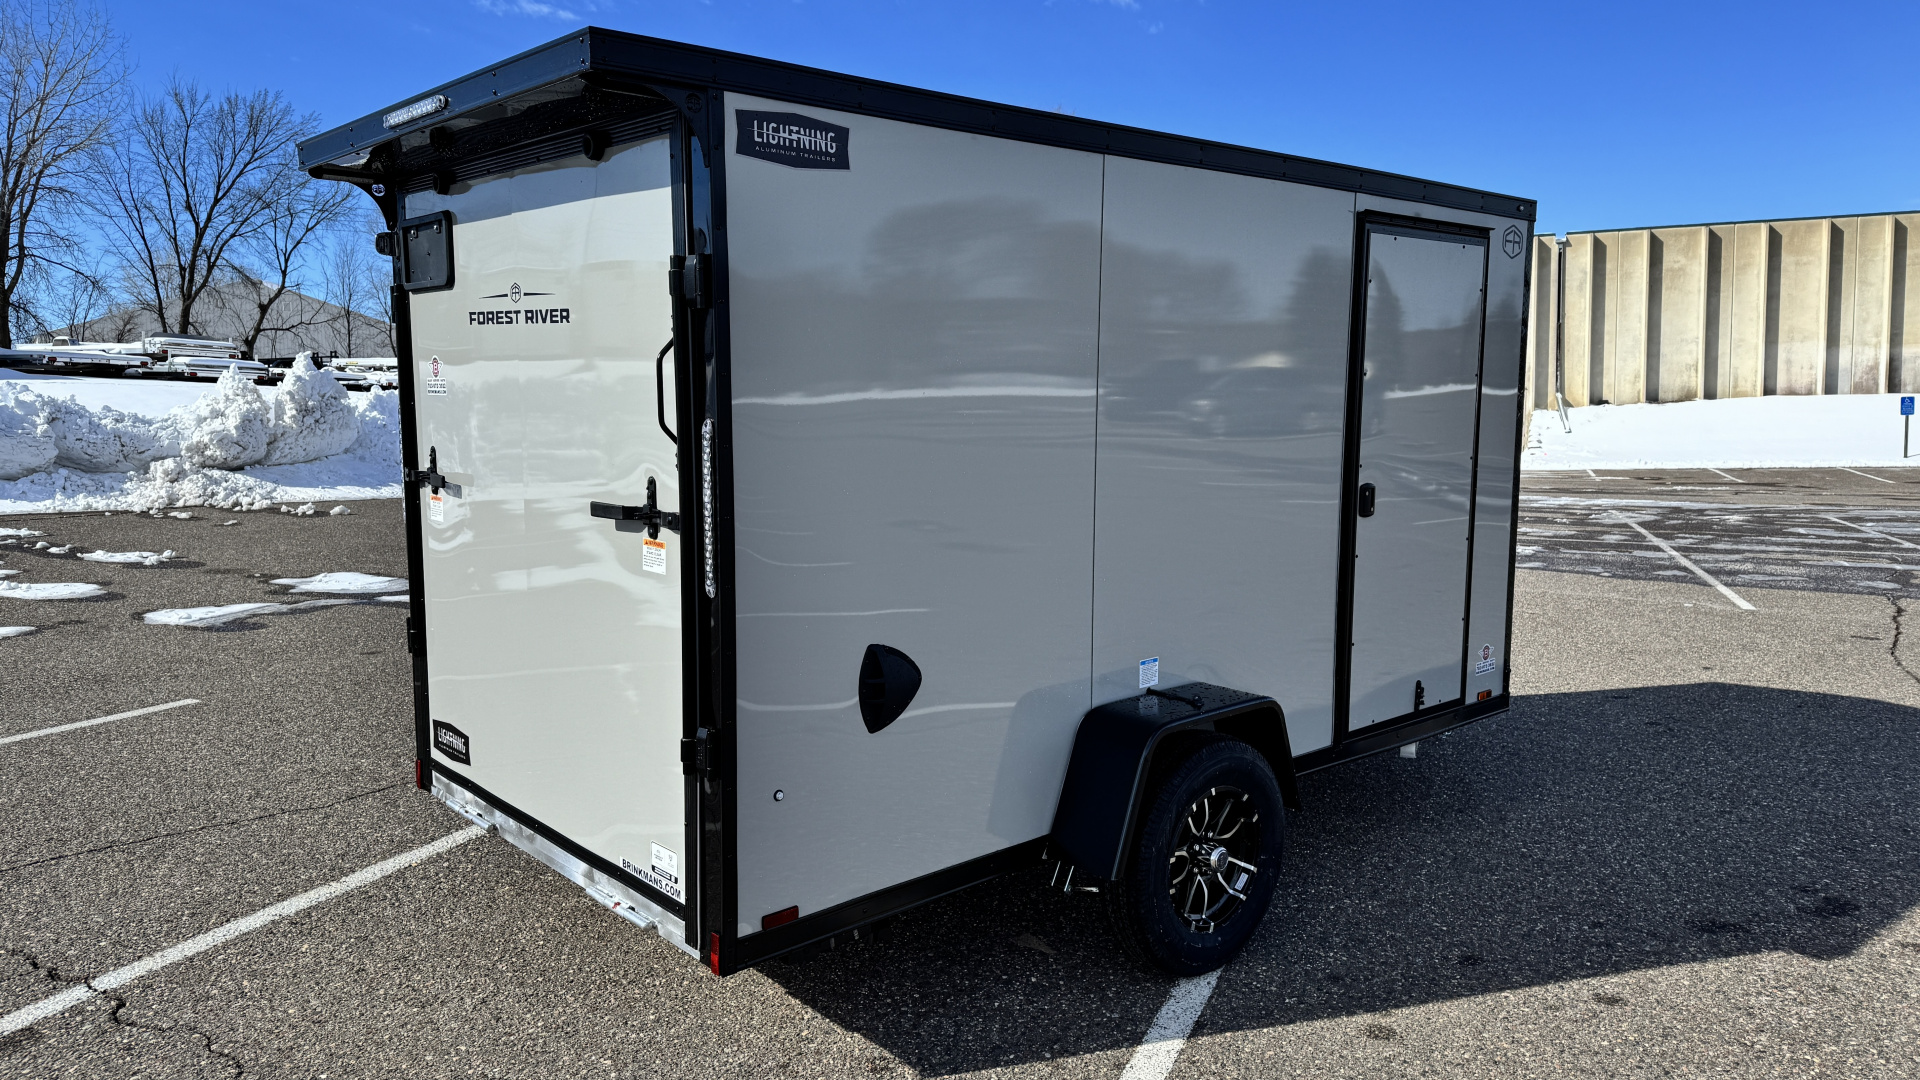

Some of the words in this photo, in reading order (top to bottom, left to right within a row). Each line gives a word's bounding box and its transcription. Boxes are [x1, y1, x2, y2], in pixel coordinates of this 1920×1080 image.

[753, 119, 837, 154] LIGHTNING
[755, 145, 797, 156] ALUMINUM
[799, 152, 836, 162] TRAILERS
[469, 309, 521, 325] FOREST
[524, 308, 570, 324] RIVER
[622, 858, 681, 900] BRINKMANS.COM
